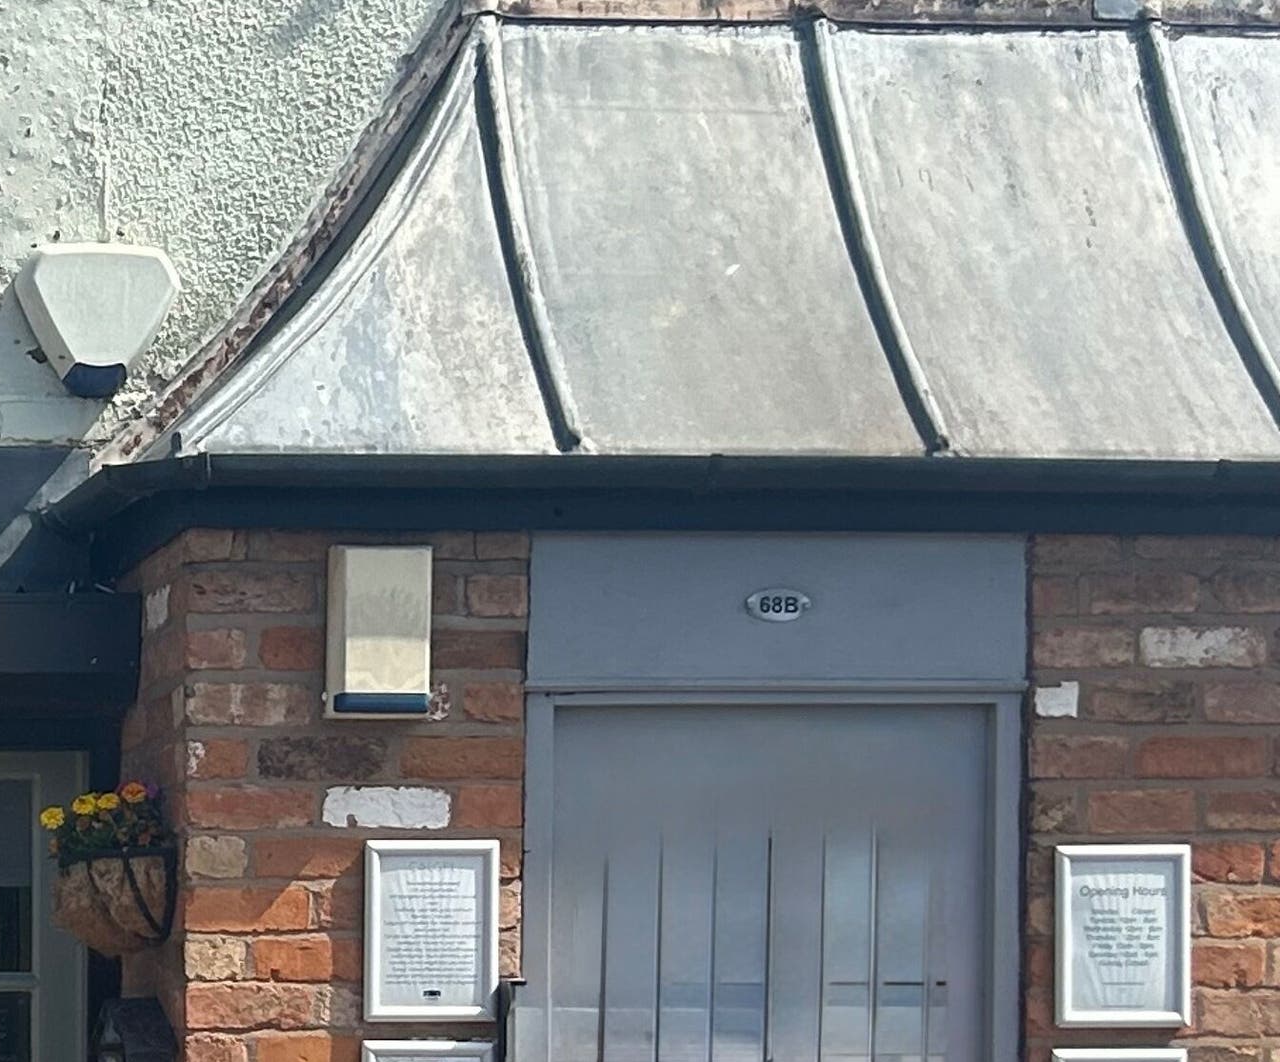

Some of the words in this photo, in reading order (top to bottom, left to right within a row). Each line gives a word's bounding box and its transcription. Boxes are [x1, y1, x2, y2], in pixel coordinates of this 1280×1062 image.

[758, 596, 800, 614] 68B
[1079, 885, 1130, 899] Opening
[1132, 886, 1168, 896] Hours
